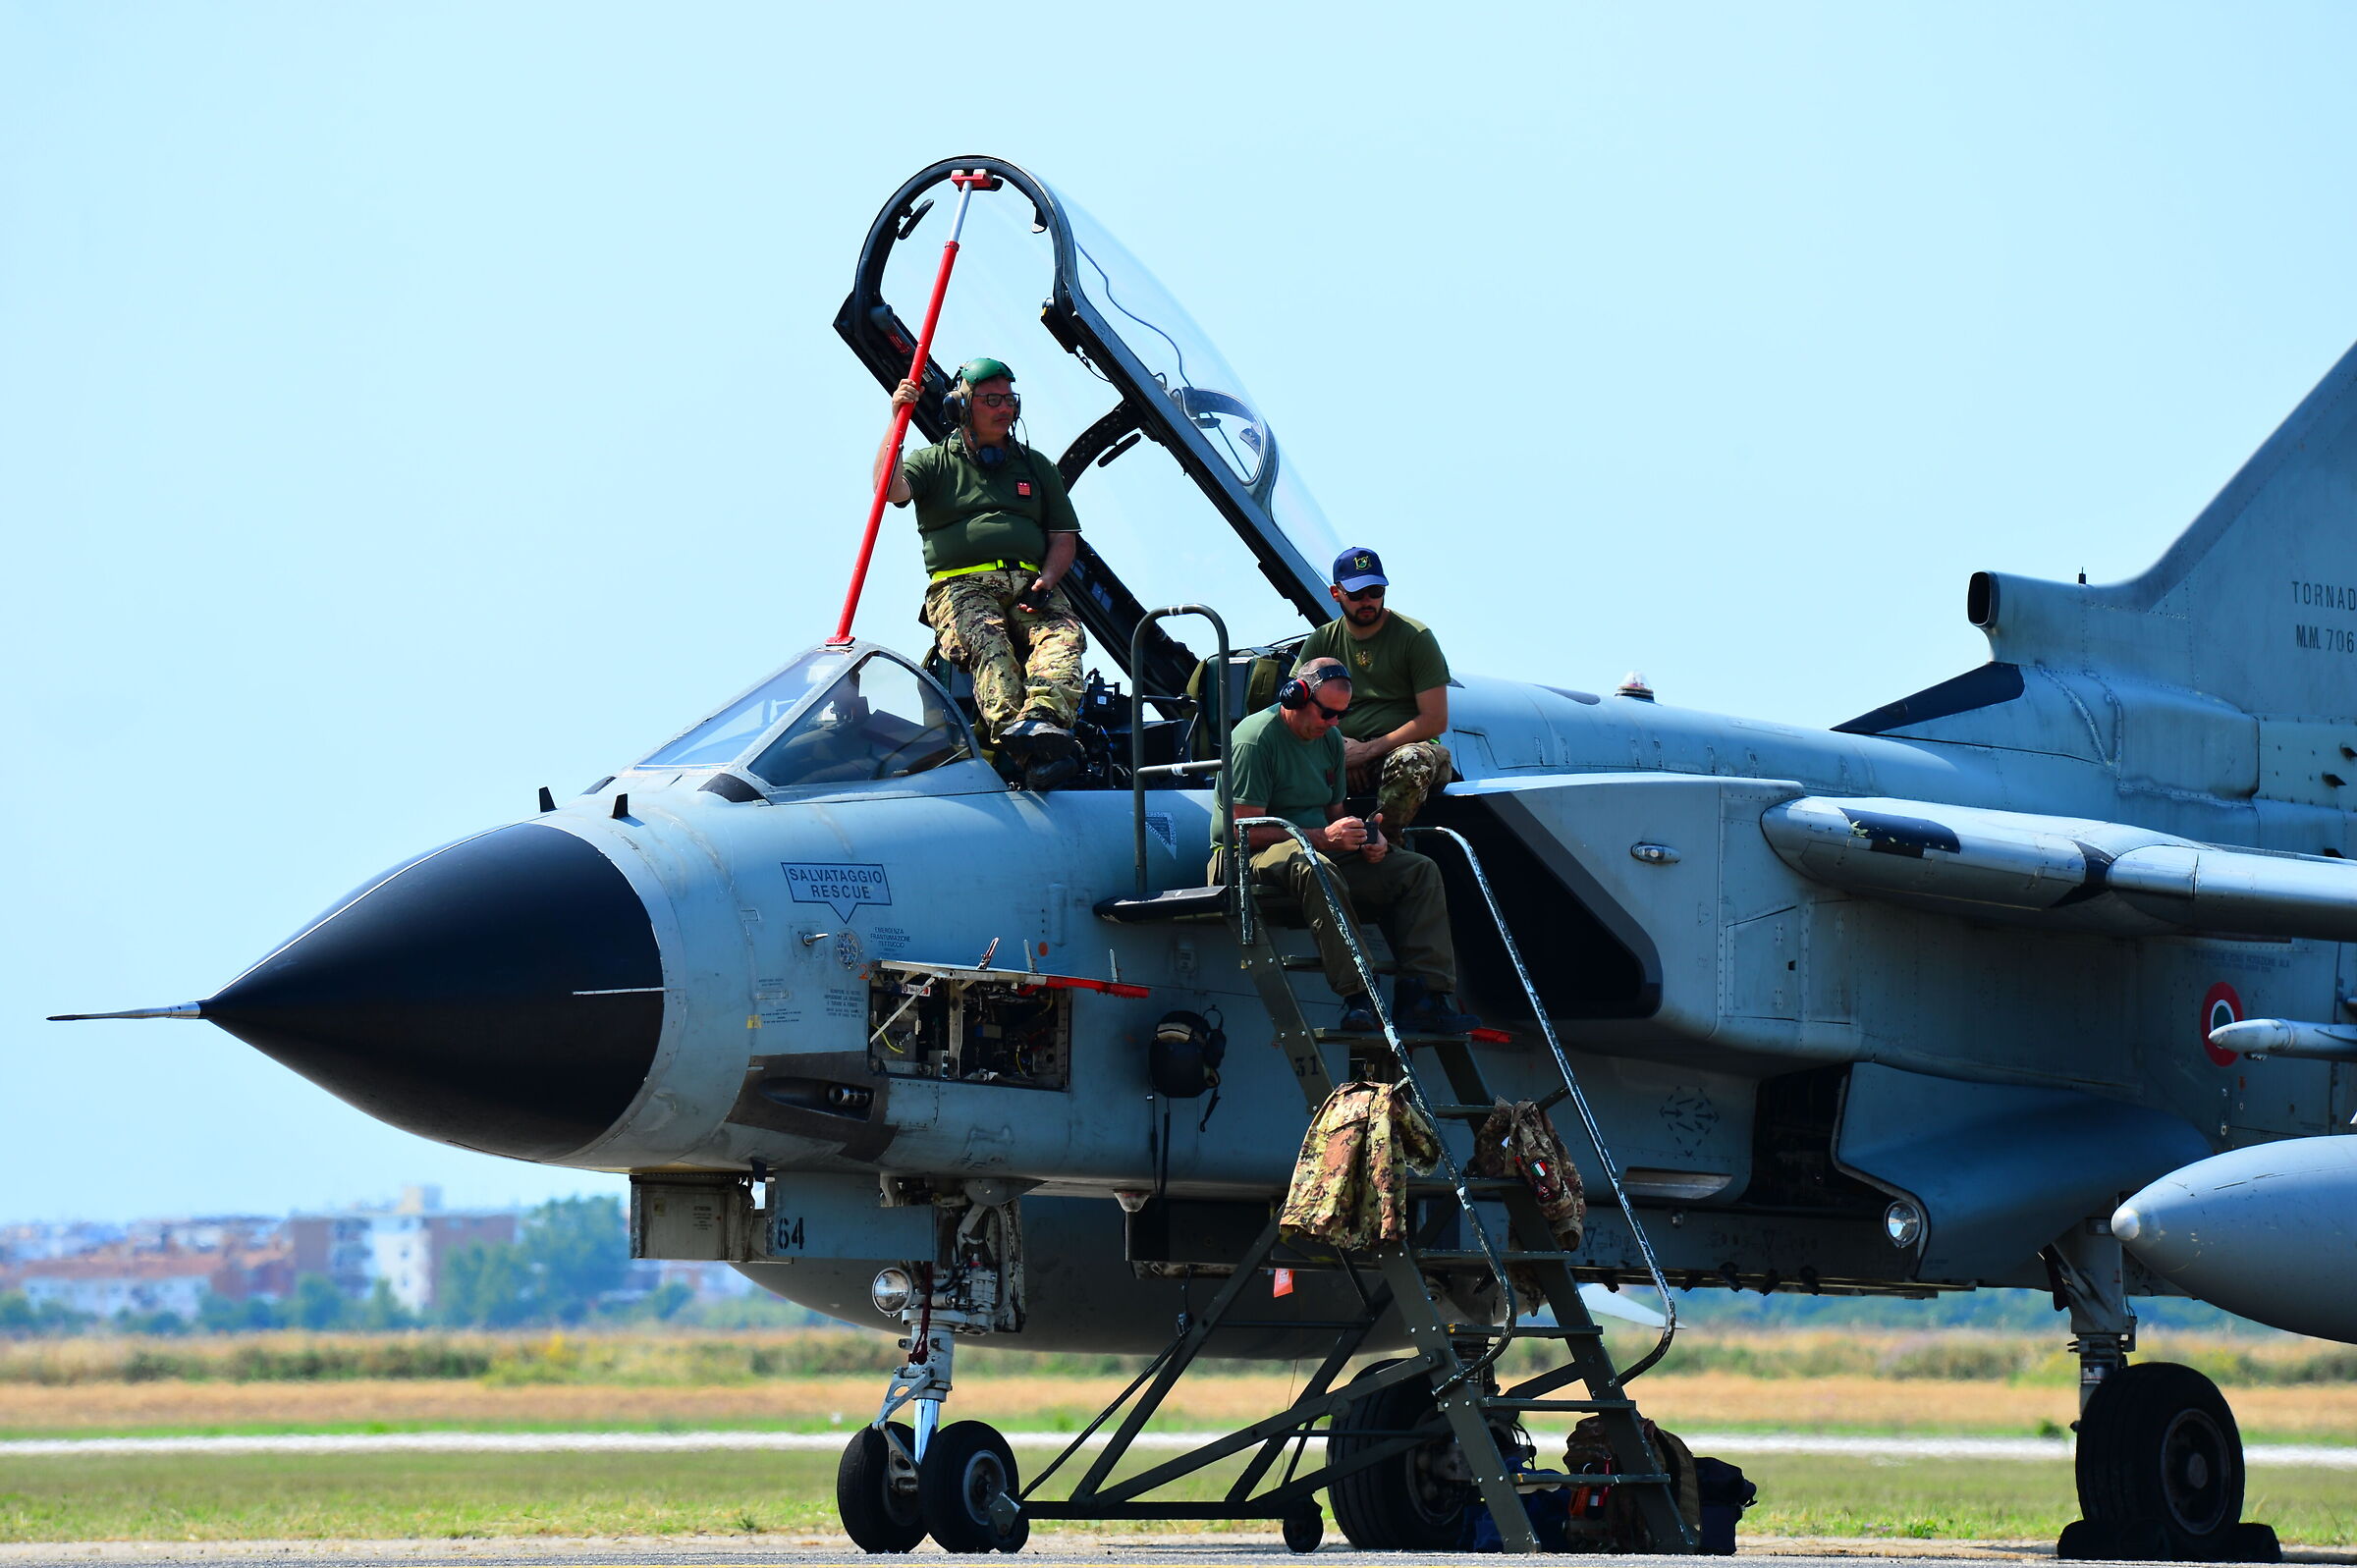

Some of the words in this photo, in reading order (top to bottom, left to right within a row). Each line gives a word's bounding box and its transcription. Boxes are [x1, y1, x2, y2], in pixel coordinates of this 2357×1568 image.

[2291, 580, 2356, 611] TORNAD
[2296, 623, 2321, 650] M.M.
[2326, 627, 2354, 653] 706
[789, 868, 883, 884] SALVATAGGIO
[810, 885, 871, 899] RESCUE
[1294, 1054, 1319, 1077] 31
[777, 1217, 805, 1250] 64
